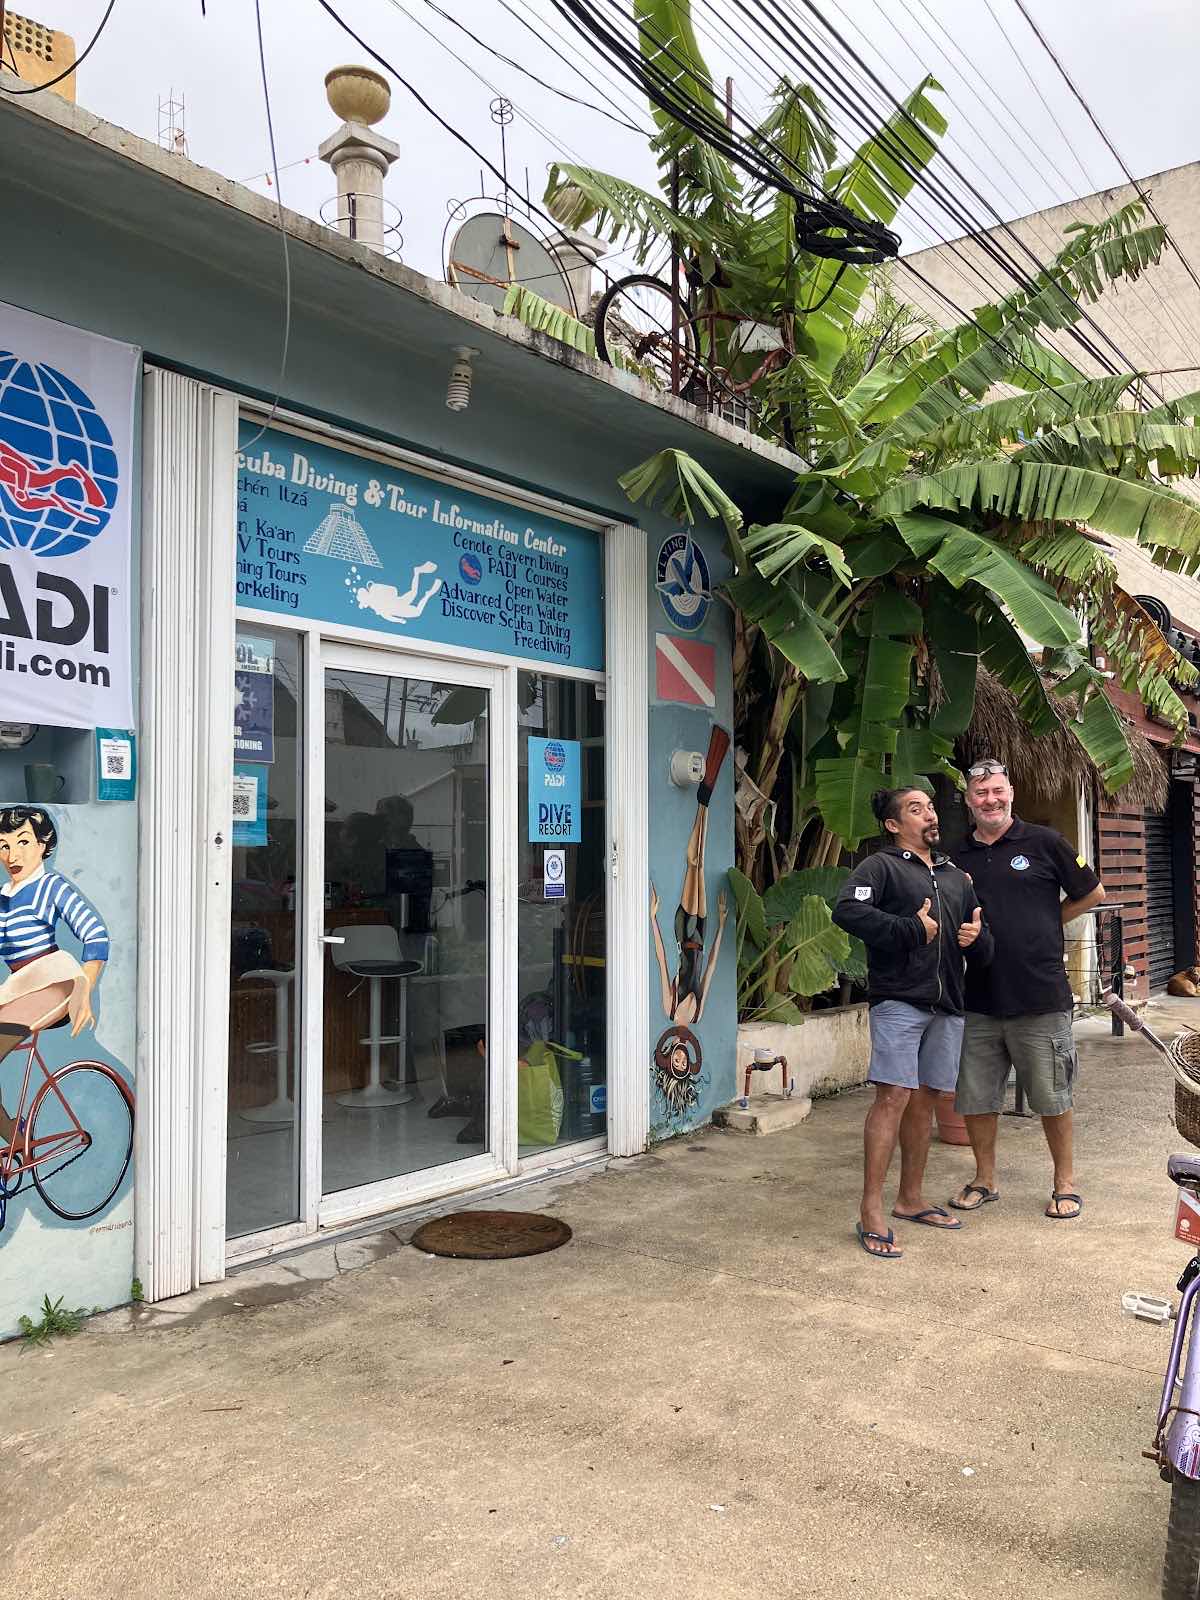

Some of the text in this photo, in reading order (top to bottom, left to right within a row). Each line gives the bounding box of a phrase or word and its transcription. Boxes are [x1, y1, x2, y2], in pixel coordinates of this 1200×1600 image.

[236, 498, 248, 513] á
[290, 453, 358, 506] Diving
[364, 479, 385, 508] &
[386, 483, 428, 519] Tour
[432, 500, 519, 545] Information
[524, 528, 567, 557] Center
[255, 518, 295, 543] Ka'an
[255, 537, 300, 565] Tours
[453, 531, 569, 582] Cenote Cavern Diving
[657, 535, 685, 580] FLYING
[265, 561, 307, 586] Tours
[488, 557, 568, 592] PADI Courses
[440, 580, 568, 623] Advanced Open Water
[505, 579, 568, 607] Open Water
[441, 598, 571, 642] Discover Scuba Diving
[513, 630, 571, 659] Freediving
[0, 640, 110, 687] i.com
[544, 774, 565, 787] PADI
[538, 803, 572, 824] DIVE
[538, 823, 572, 836] RESORT
